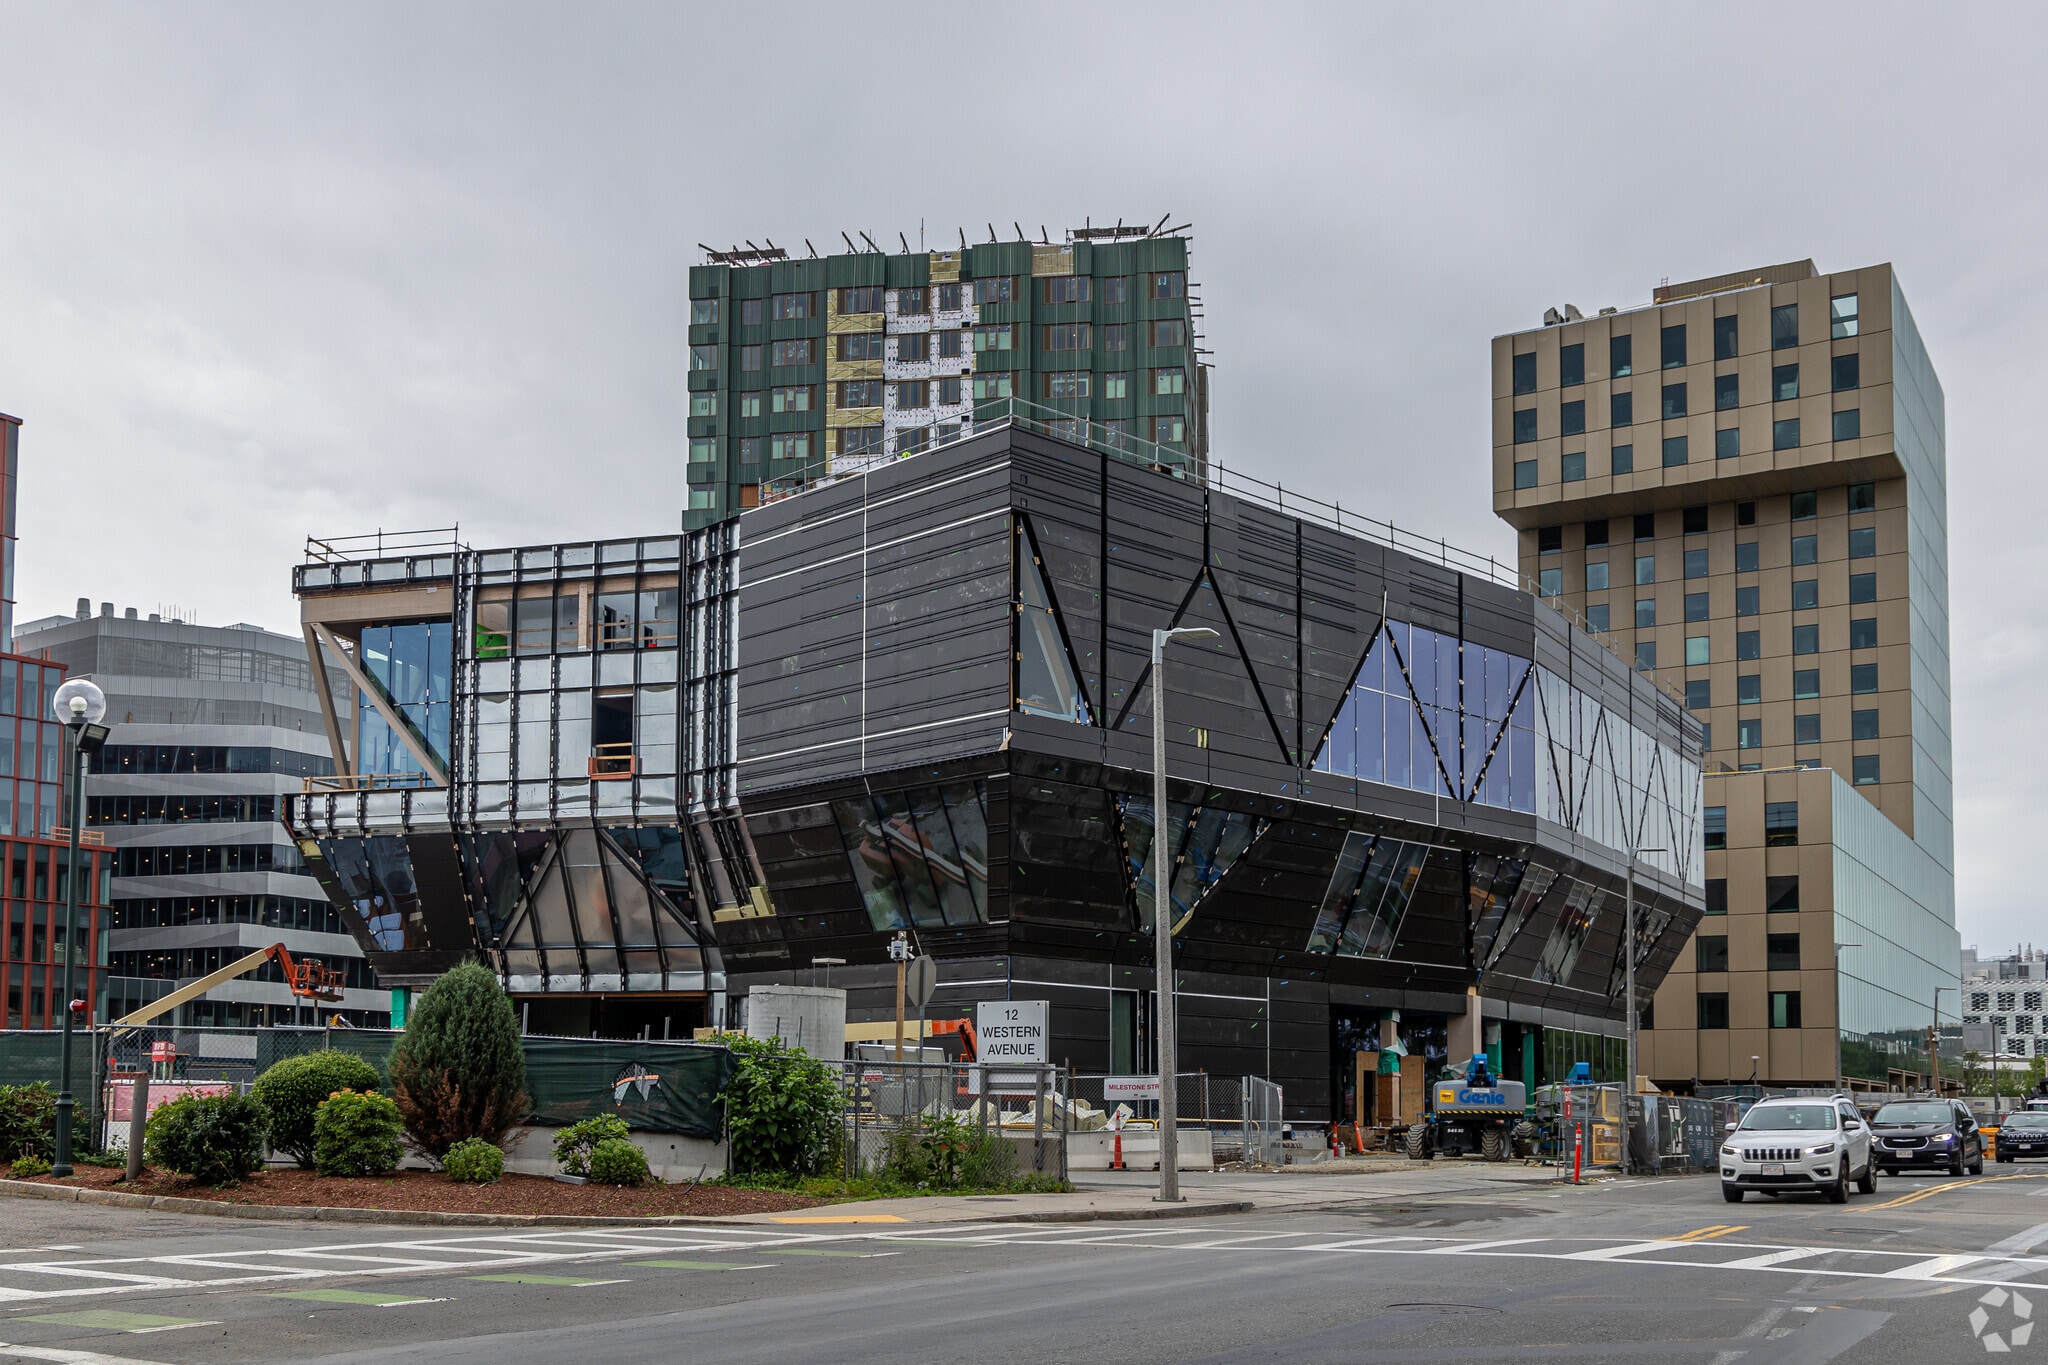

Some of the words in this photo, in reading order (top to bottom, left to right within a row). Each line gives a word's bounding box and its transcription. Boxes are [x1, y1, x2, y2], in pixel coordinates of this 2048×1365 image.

[1005, 1009, 1018, 1020] 12
[982, 1026, 1040, 1037] WESTERN
[987, 1043, 1035, 1055] AVENUE
[1458, 1089, 1505, 1104] Genie
